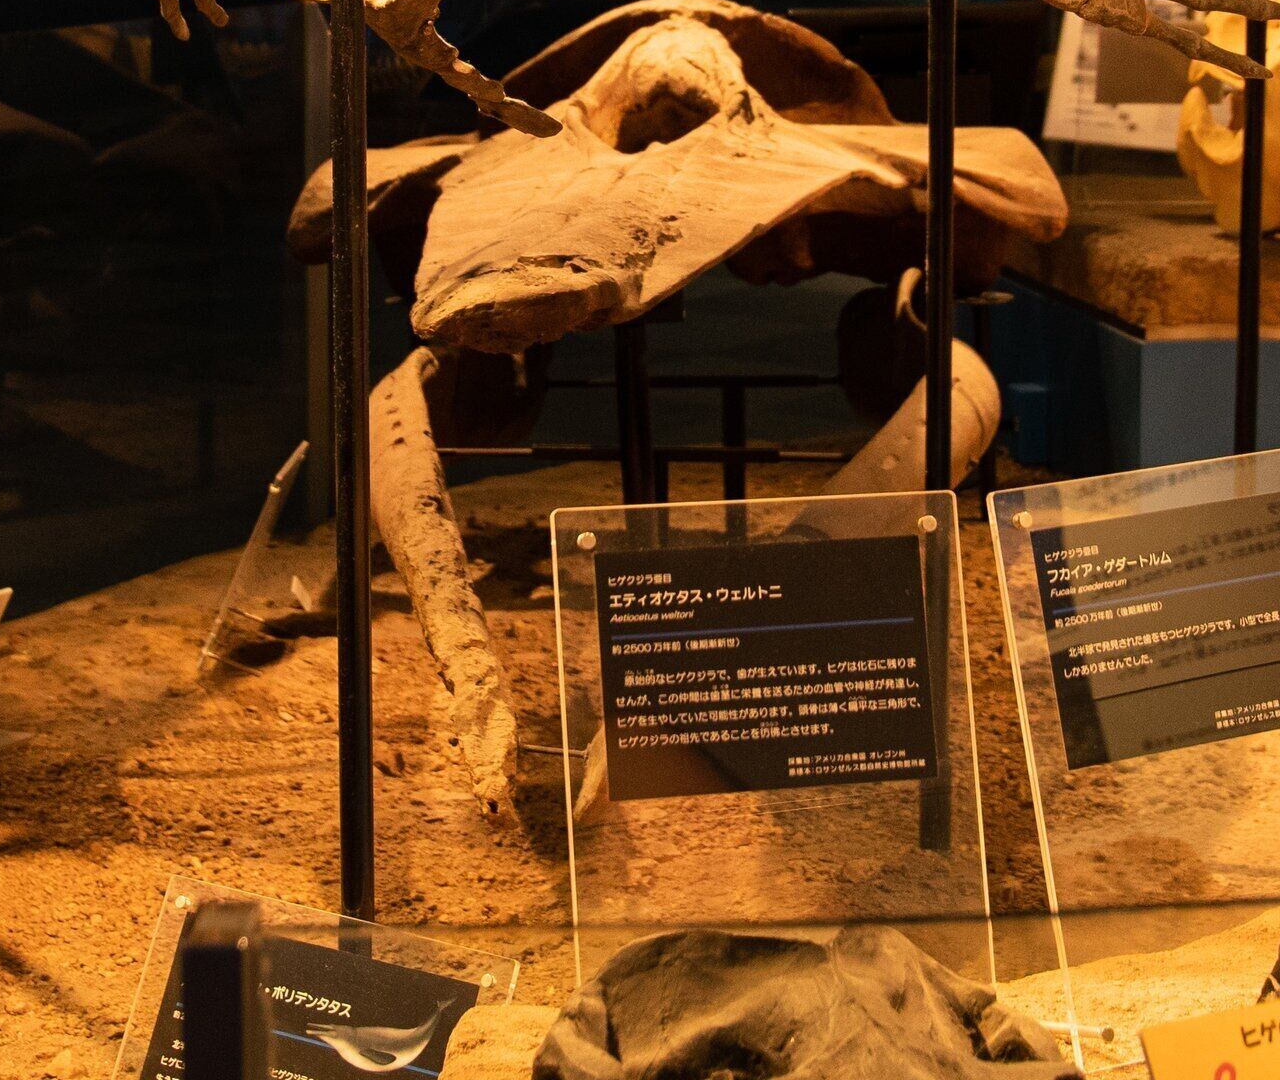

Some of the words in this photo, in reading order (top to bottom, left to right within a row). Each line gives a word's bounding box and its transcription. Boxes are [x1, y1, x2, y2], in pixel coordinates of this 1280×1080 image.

[1046, 549, 1171, 583] フカイア・ゲダートルム
[608, 584, 782, 608] エティオケタス・ウェルトニ
[1049, 585, 1076, 598] Fucaia
[609, 611, 658, 624] Aetiocetus
[660, 609, 694, 620] weltoni
[1063, 653, 1154, 679] しかありませんでした。
[258, 983, 353, 1018] ・ポリデンタタス
